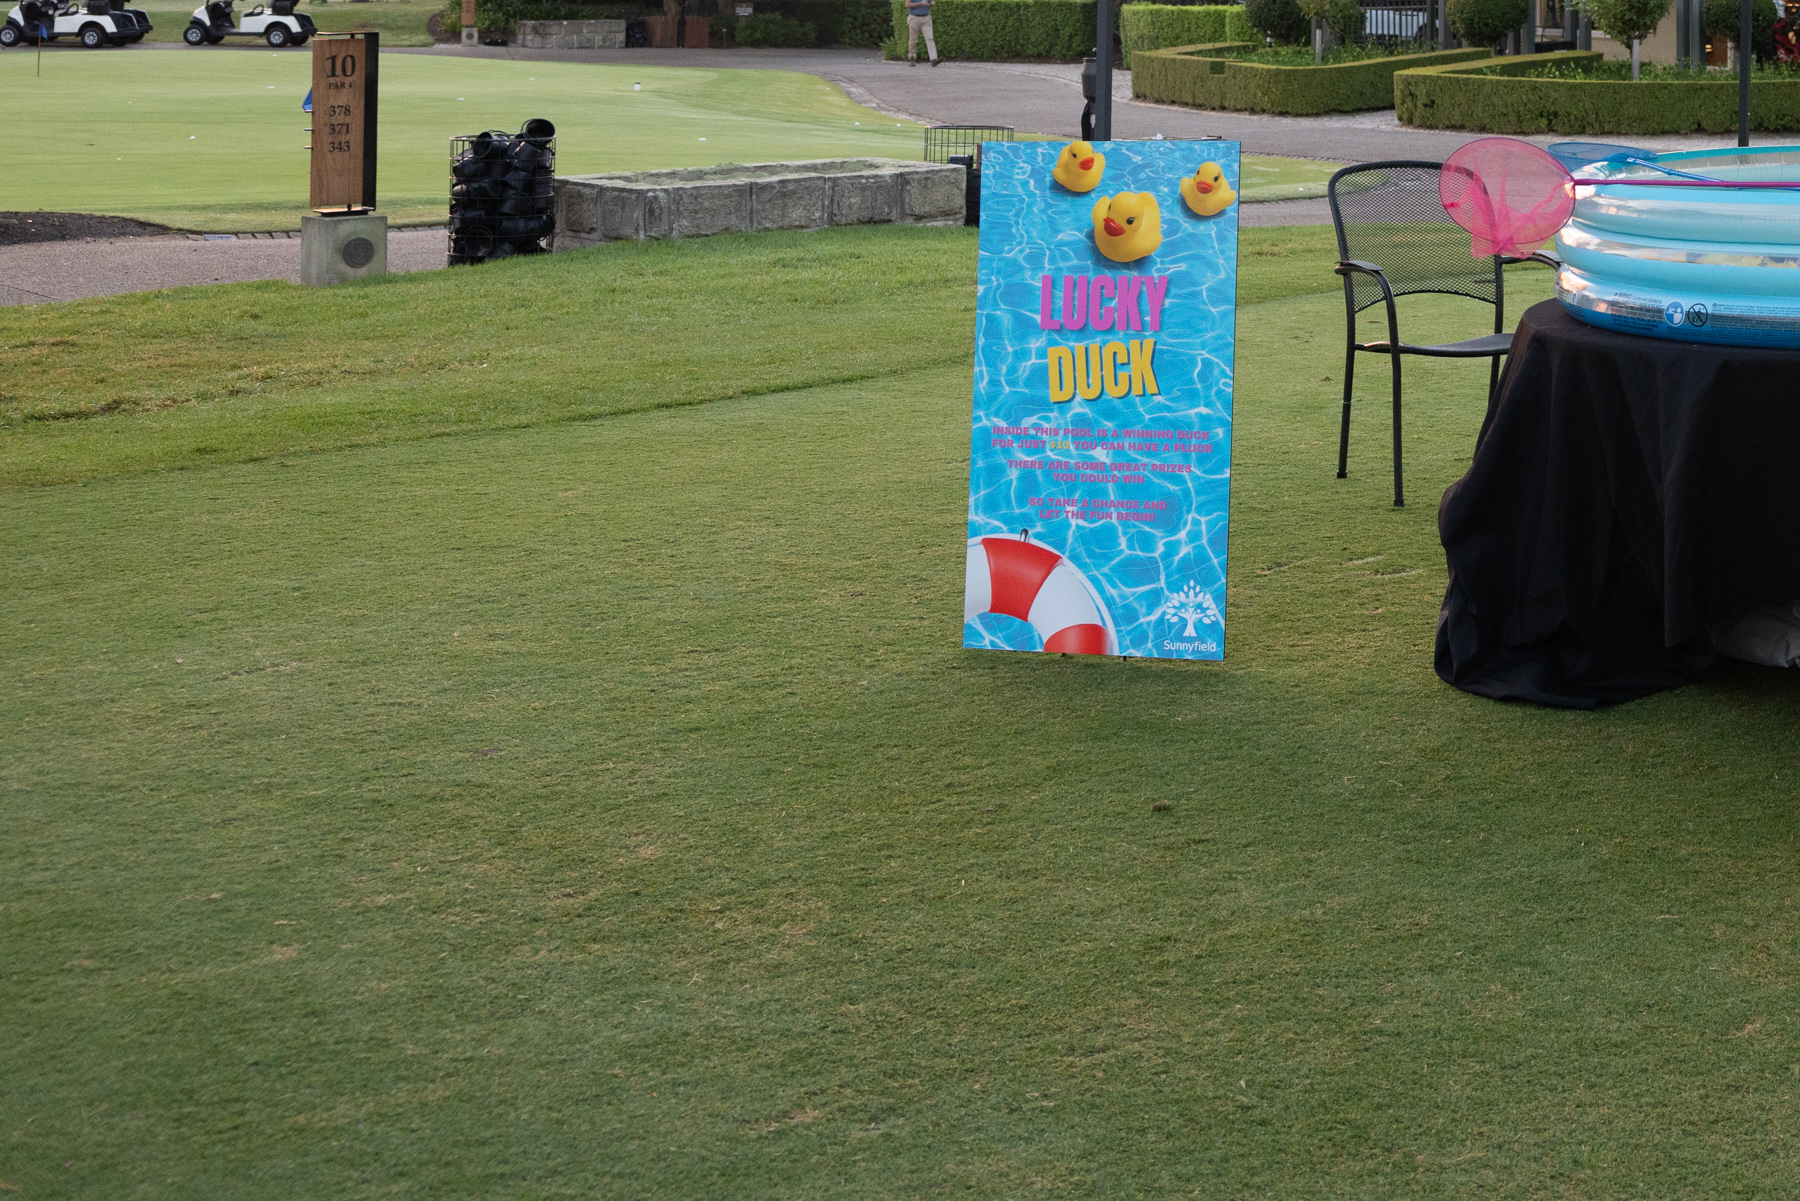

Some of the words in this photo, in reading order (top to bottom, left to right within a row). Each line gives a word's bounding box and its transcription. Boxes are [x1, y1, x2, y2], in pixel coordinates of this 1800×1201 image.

[326, 54, 356, 78] 10
[328, 81, 346, 90] PAR
[348, 81, 353, 89] 4
[328, 104, 351, 117] 378
[328, 122, 351, 135] 371
[328, 140, 351, 153] 343
[1040, 274, 1170, 331] LUCKY
[1047, 338, 1160, 403] DUCK
[992, 426, 1030, 436] INSIDE
[1033, 427, 1060, 437] THIS
[1063, 427, 1094, 438] POOL
[1096, 428, 1108, 438] IS
[1111, 428, 1119, 438] A
[1122, 429, 1174, 439] WINNING
[1176, 430, 1210, 440] DUCK
[991, 438, 1014, 448] FOR
[1017, 439, 1047, 449] JUST
[1049, 440, 1070, 450] $10
[1073, 440, 1098, 450] YOU
[1100, 441, 1125, 451] CAN
[1128, 442, 1160, 452] HAVE
[1162, 443, 1171, 452] A
[1173, 443, 1213, 453] PLUCK
[1006, 459, 1045, 469] THERE
[1047, 460, 1071, 470] ARE
[1073, 461, 1106, 471] SOME
[1109, 462, 1148, 472] GREAT
[1150, 463, 1192, 473] PRIZES
[1052, 472, 1077, 482] YOU
[1080, 473, 1119, 483] COULD
[1122, 474, 1145, 484] WIN
[1028, 497, 1044, 506] SO
[1047, 497, 1078, 507] TAKE
[1081, 498, 1089, 508] A
[1092, 499, 1140, 509] CHANCE
[1142, 500, 1167, 510] AND
[1039, 509, 1060, 519] LET
[1064, 510, 1086, 519] THE
[1089, 511, 1113, 520] FUN
[1116, 511, 1156, 522] BEGIN!
[1163, 639, 1217, 653] Sunnyfield
